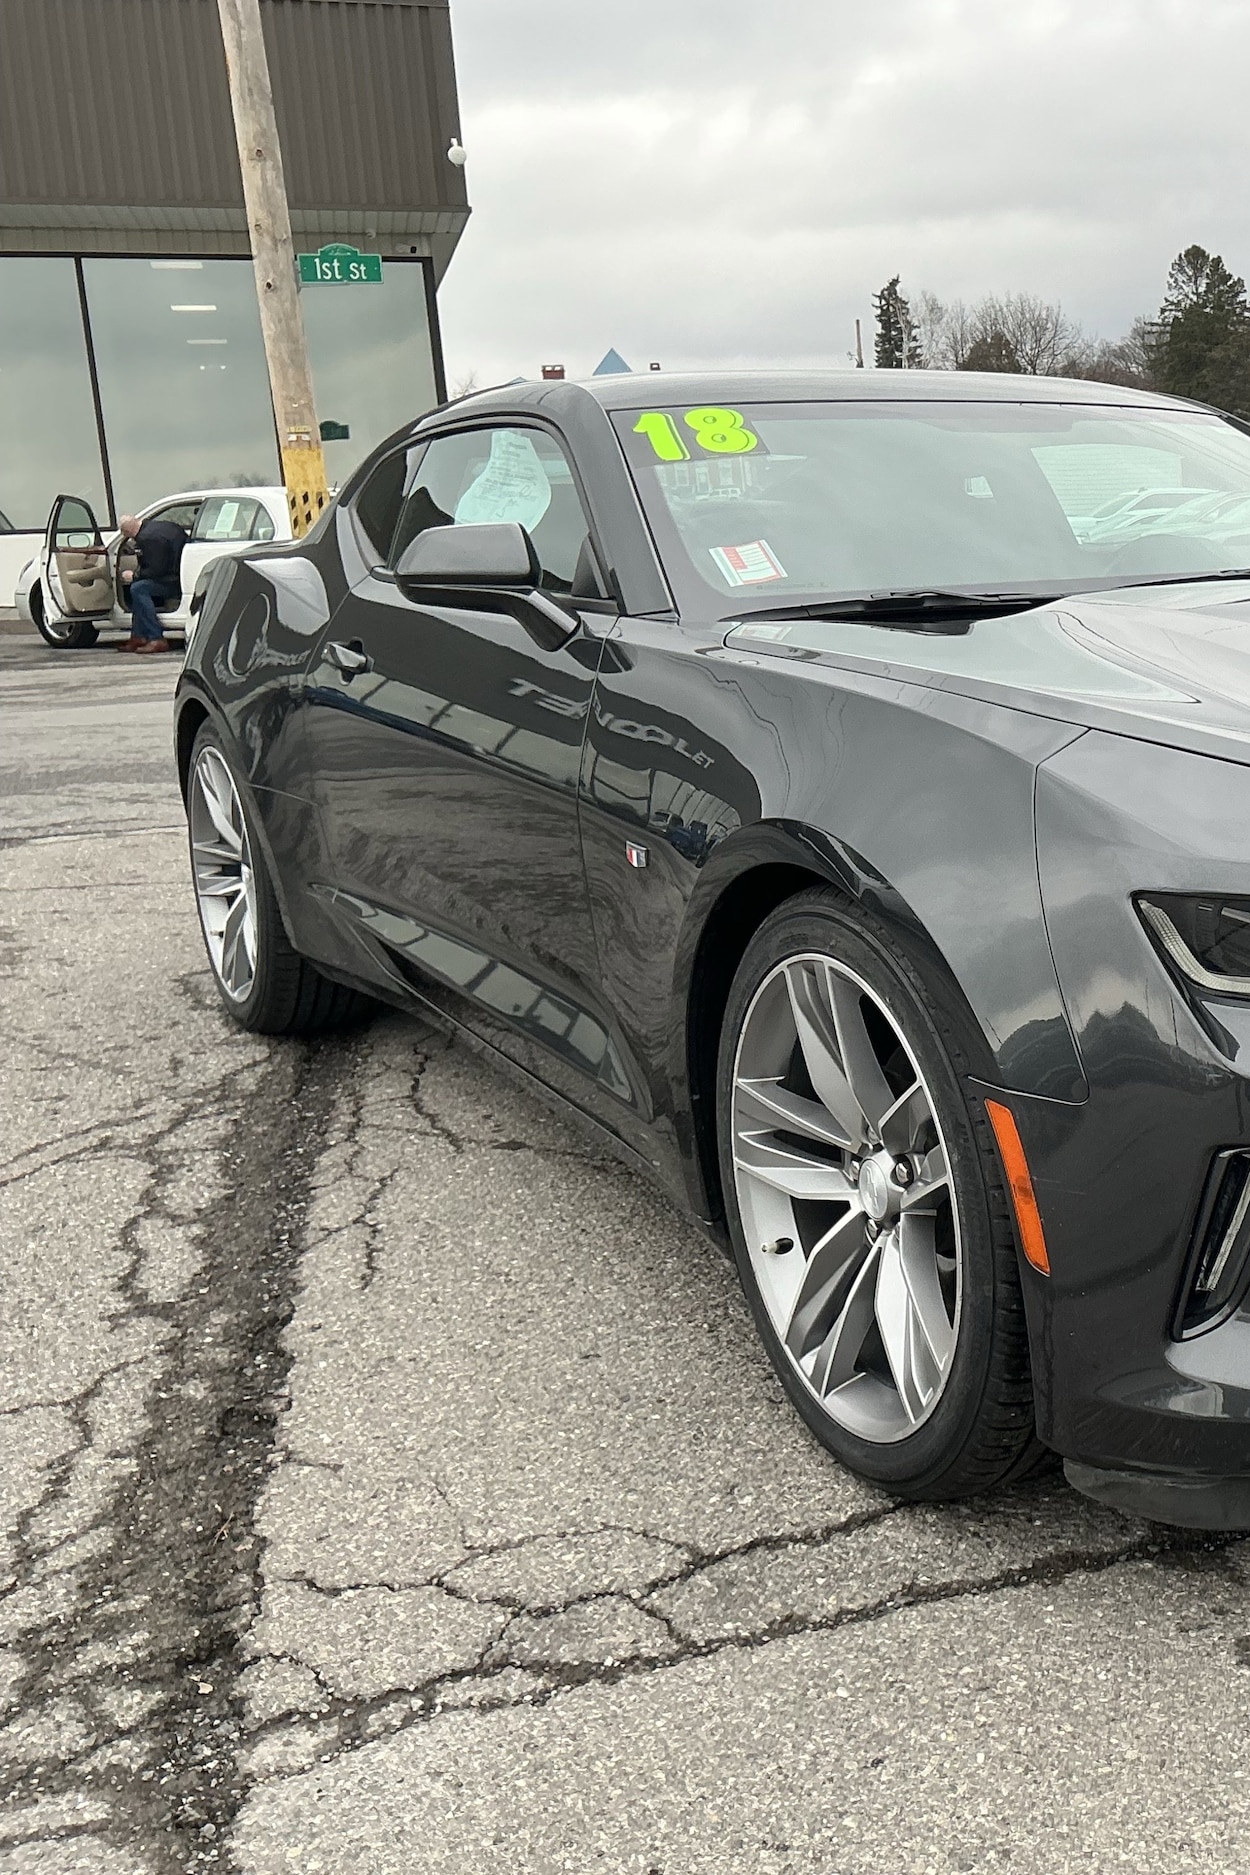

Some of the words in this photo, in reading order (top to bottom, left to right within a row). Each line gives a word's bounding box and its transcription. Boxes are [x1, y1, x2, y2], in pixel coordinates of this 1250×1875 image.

[314, 258, 342, 280] 1st
[349, 262, 367, 280] St
[633, 407, 758, 461] 18
